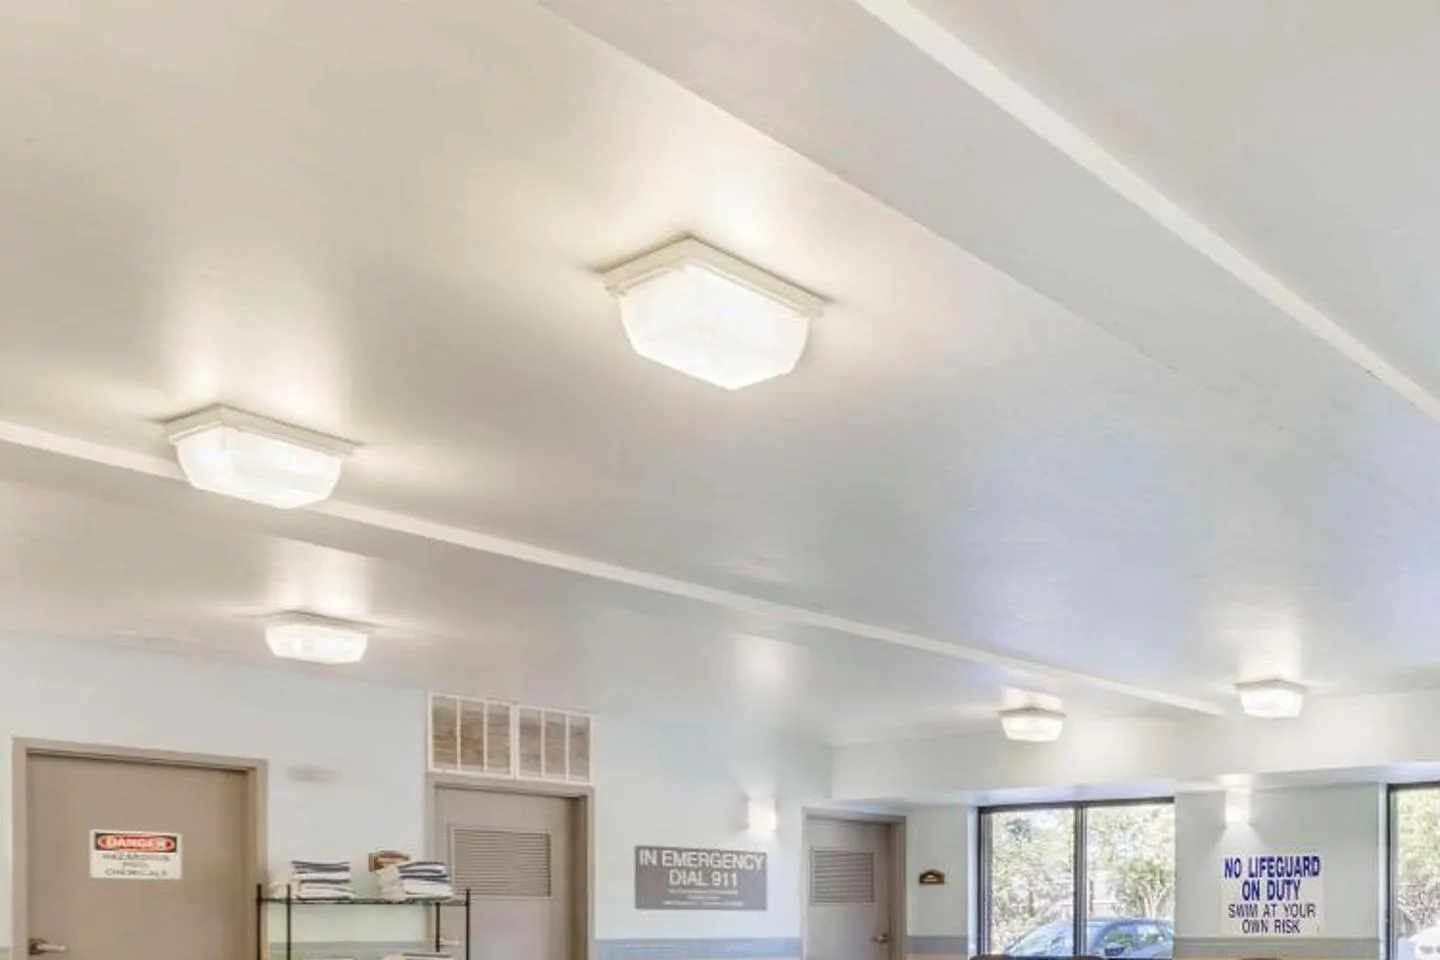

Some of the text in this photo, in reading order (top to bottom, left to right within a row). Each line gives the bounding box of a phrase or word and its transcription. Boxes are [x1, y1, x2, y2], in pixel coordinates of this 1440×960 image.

[108, 836, 166, 849] DANGER
[639, 849, 764, 870] IN EMERGENCY
[1225, 855, 1321, 878] NO LIFEGUARD
[669, 869, 737, 887] DIAL 911
[1242, 879, 1301, 900] ON DUTY
[1228, 903, 1316, 918] SWIM AT YOUR
[1242, 920, 1301, 933] OWN RISK
